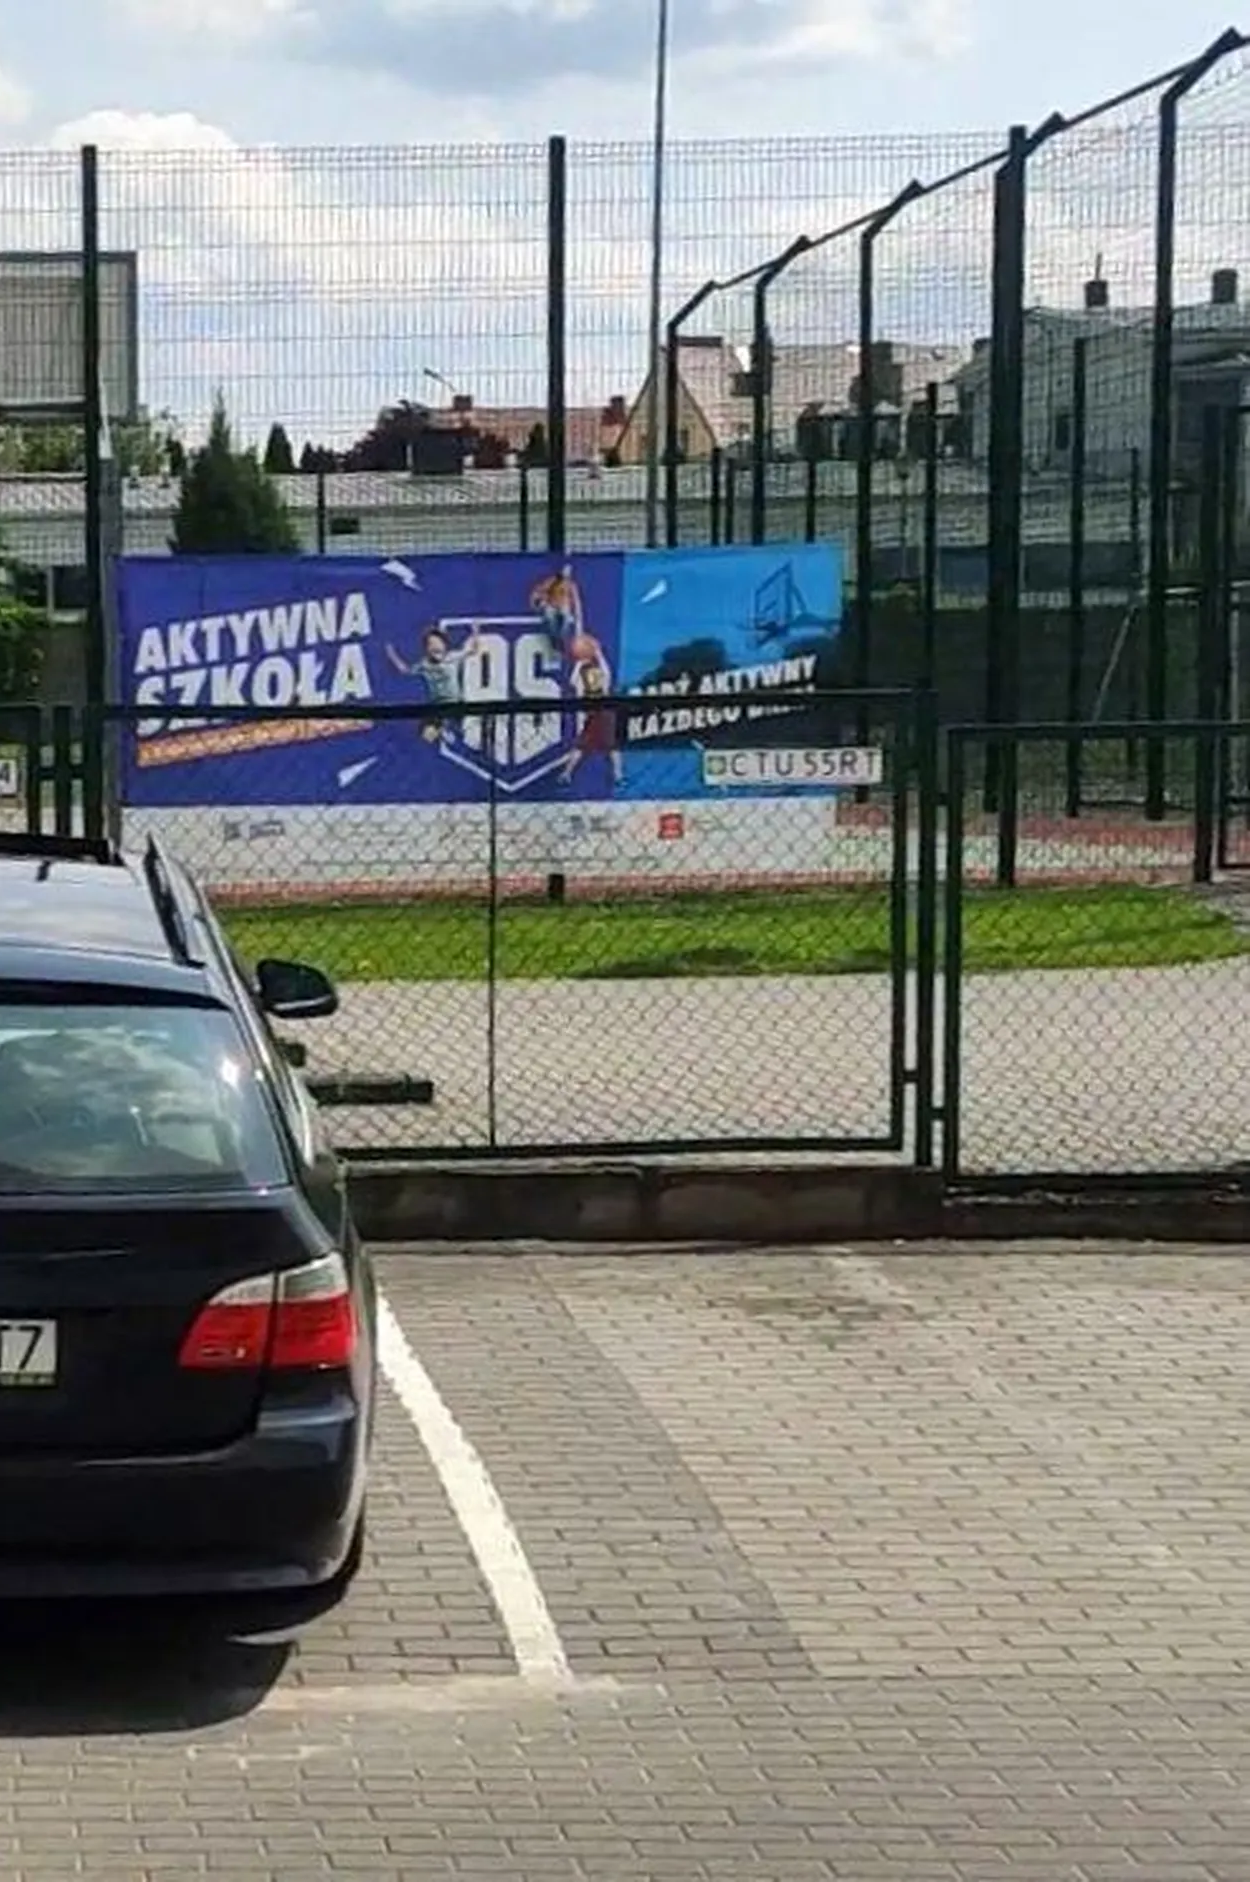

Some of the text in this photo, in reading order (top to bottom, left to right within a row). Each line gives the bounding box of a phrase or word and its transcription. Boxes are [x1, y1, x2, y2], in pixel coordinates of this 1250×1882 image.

[134, 592, 372, 674] AKTYWNA
[135, 644, 373, 738] SZKOŁA
[698, 654, 818, 695] AKTYWNY
[730, 751, 795, 777] CTU
